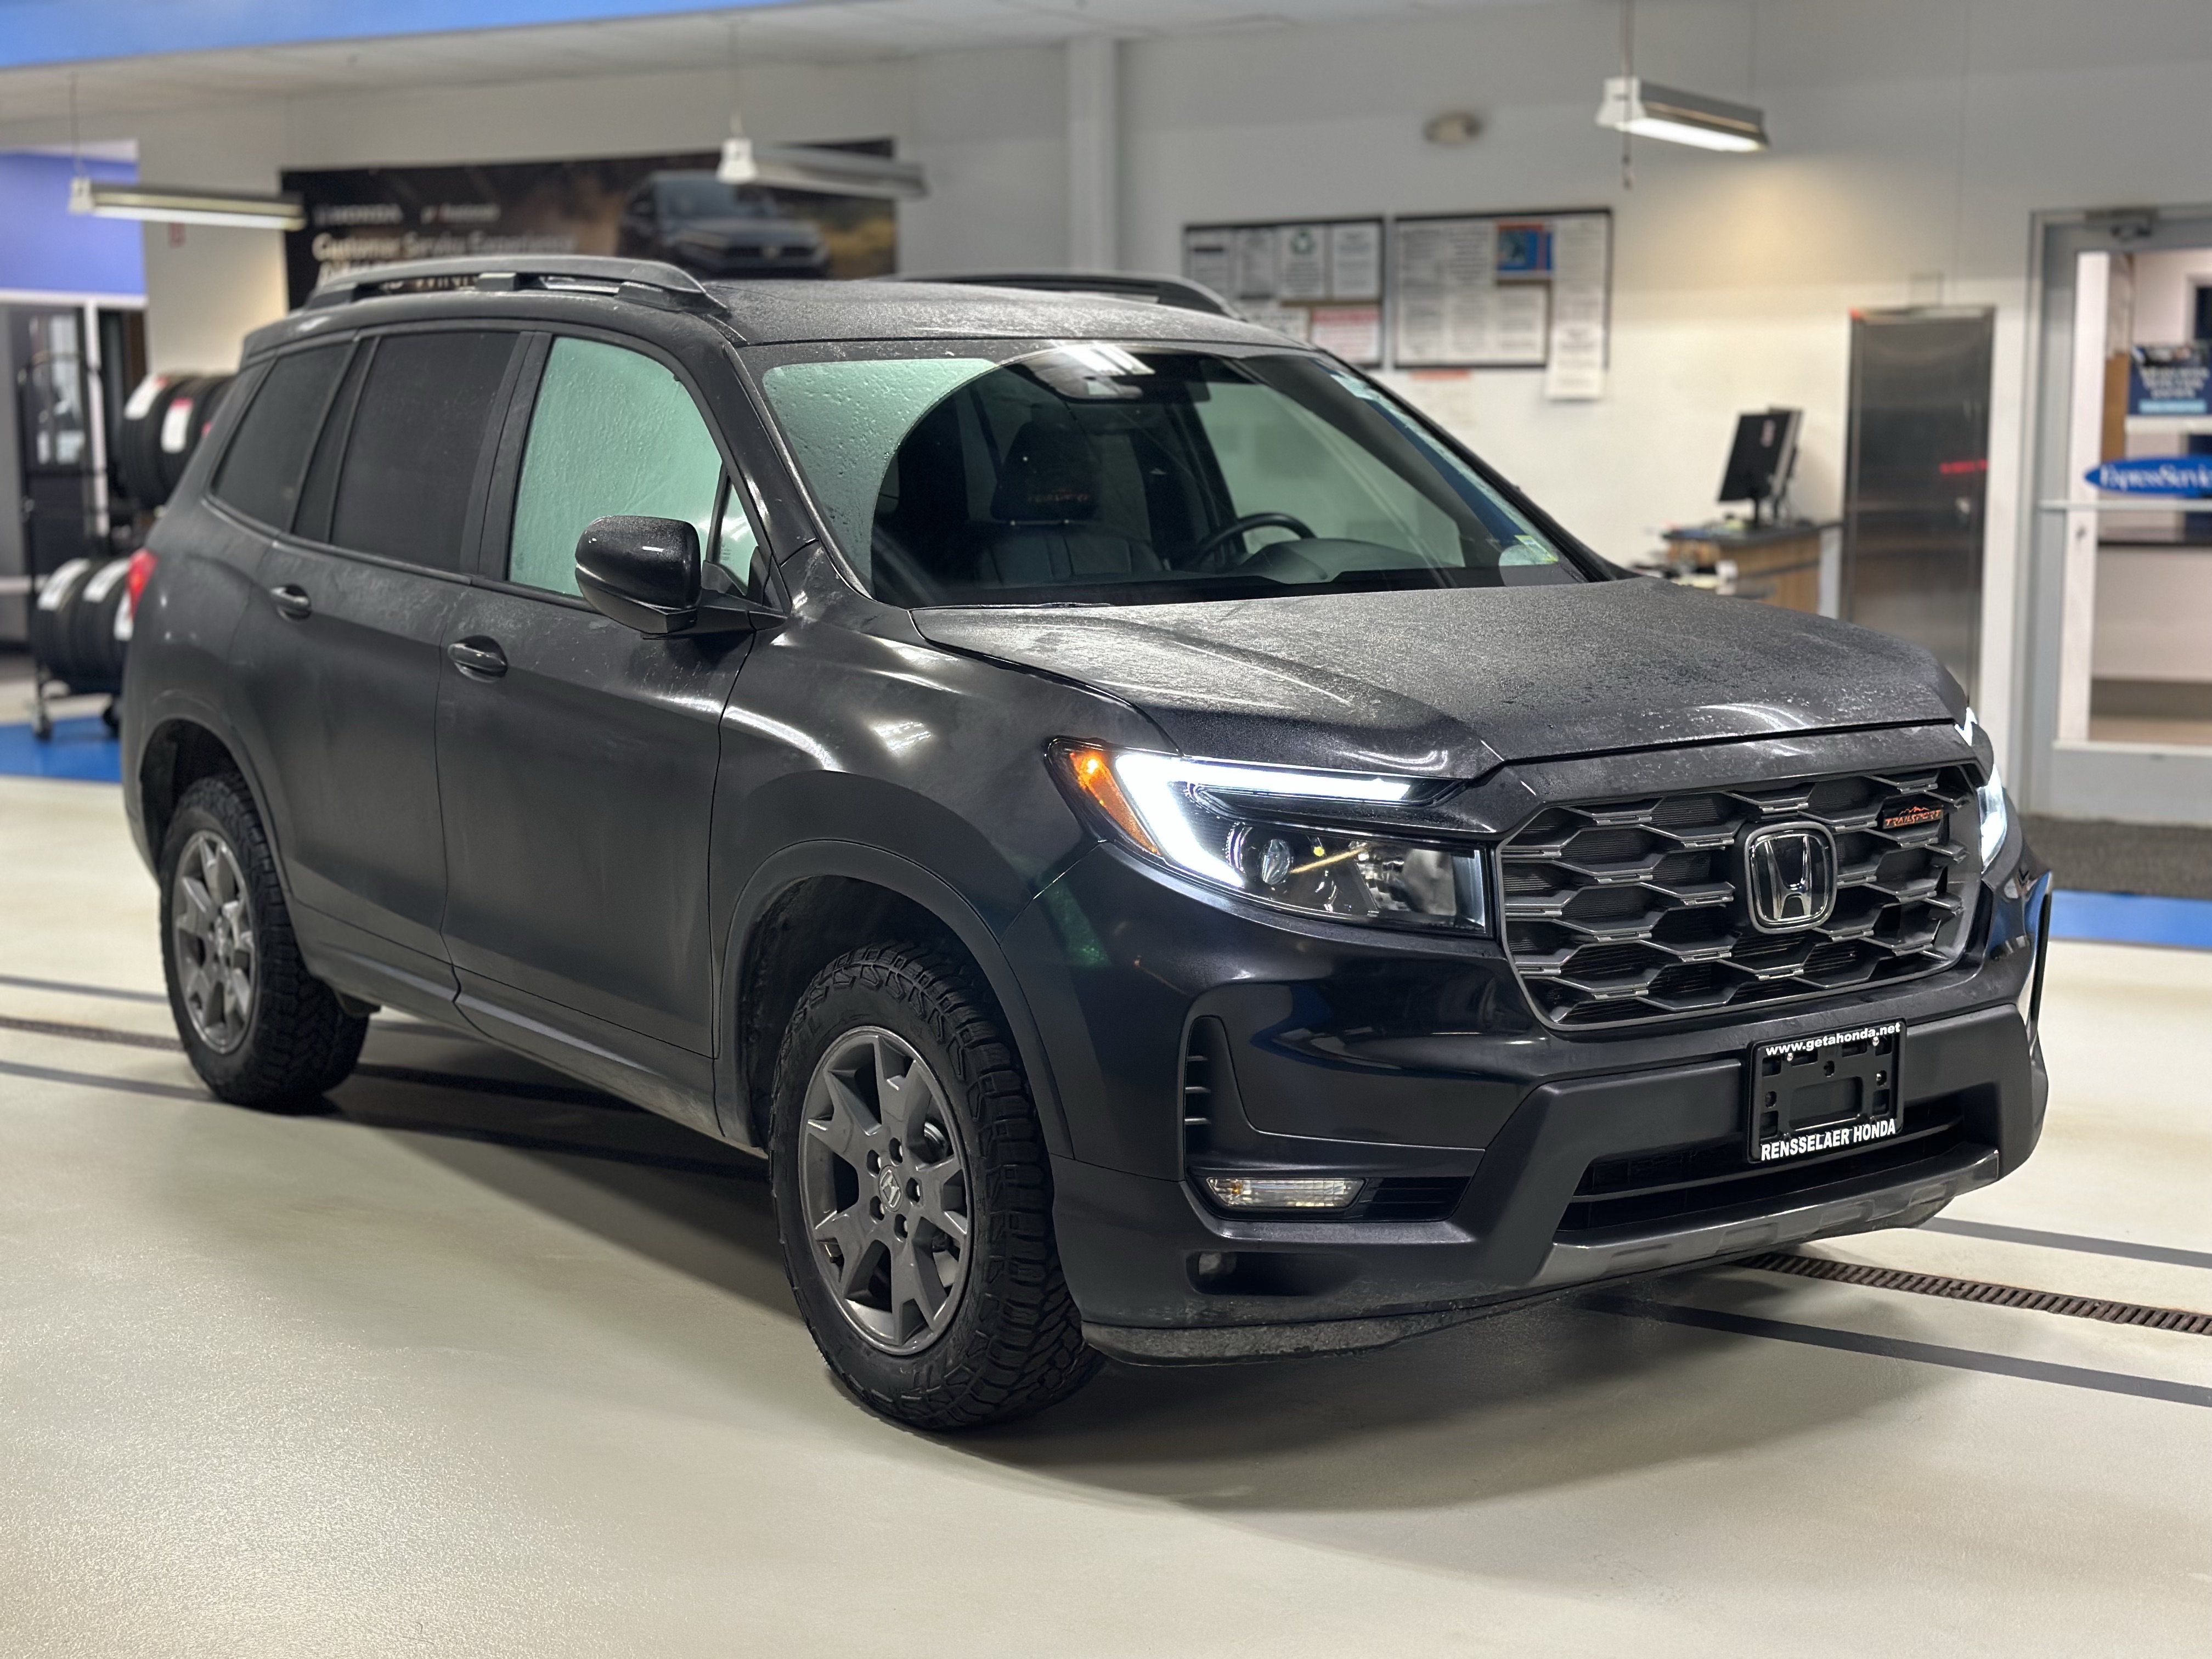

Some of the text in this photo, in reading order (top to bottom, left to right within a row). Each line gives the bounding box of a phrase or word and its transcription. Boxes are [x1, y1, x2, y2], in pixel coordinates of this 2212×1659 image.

[313, 233, 400, 261] Customer
[1885, 809, 1941, 827] TRAILSPORT
[1765, 1022, 1900, 1056] www.getahonda.net
[1760, 1118, 1896, 1161] RENSSELAER HONDA
